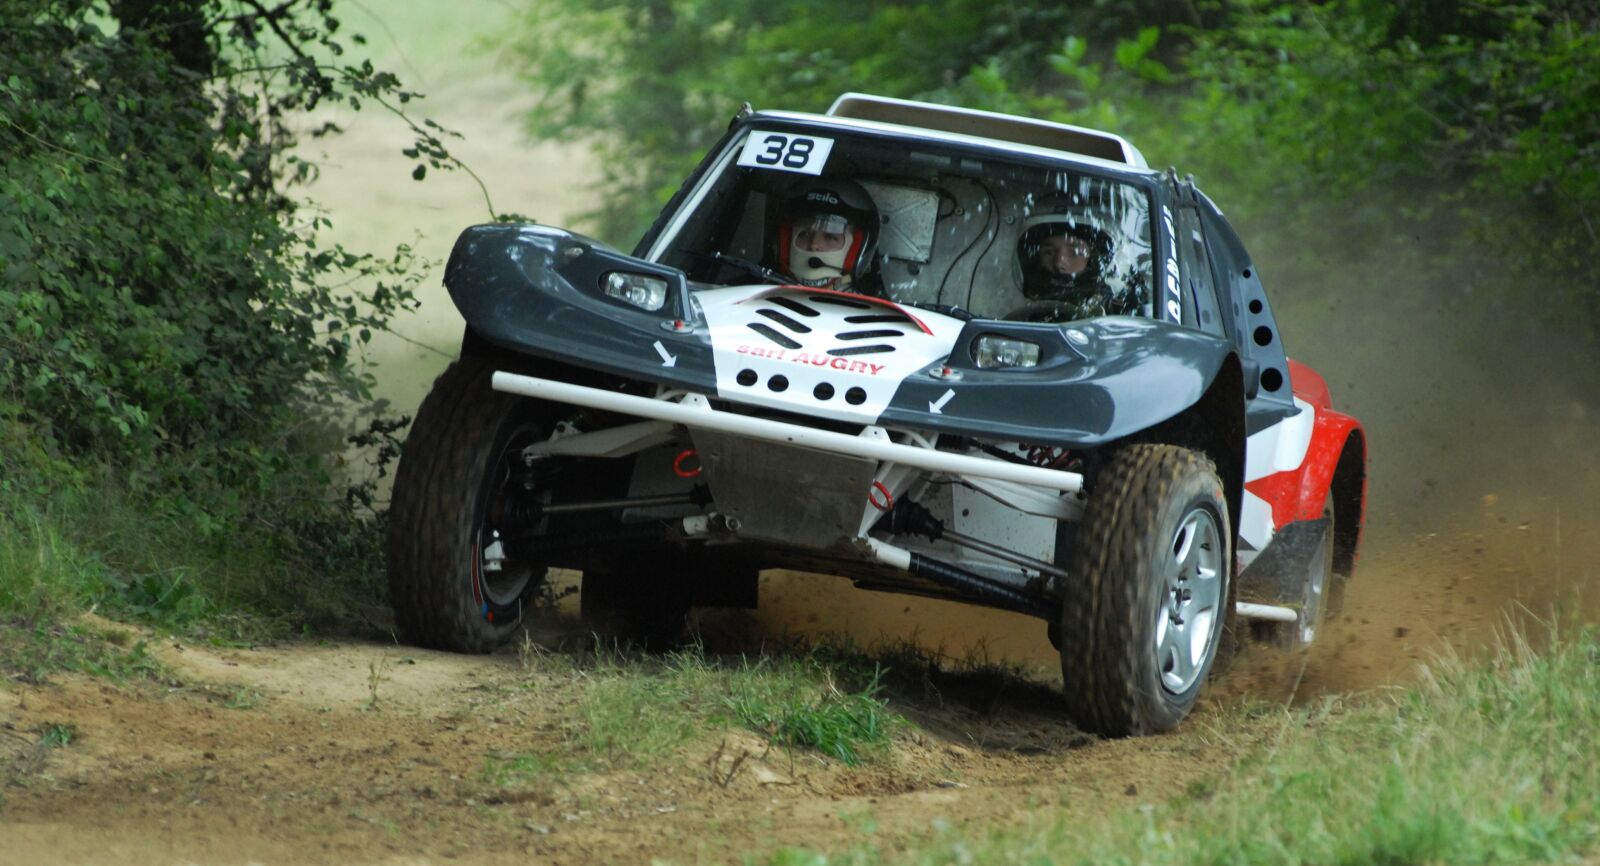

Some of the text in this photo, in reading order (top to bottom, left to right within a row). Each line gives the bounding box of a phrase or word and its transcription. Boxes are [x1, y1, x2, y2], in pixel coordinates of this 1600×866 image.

[755, 135, 815, 169] 38
[806, 191, 839, 205] stilo
[736, 343, 887, 376] sarl AUGRY
